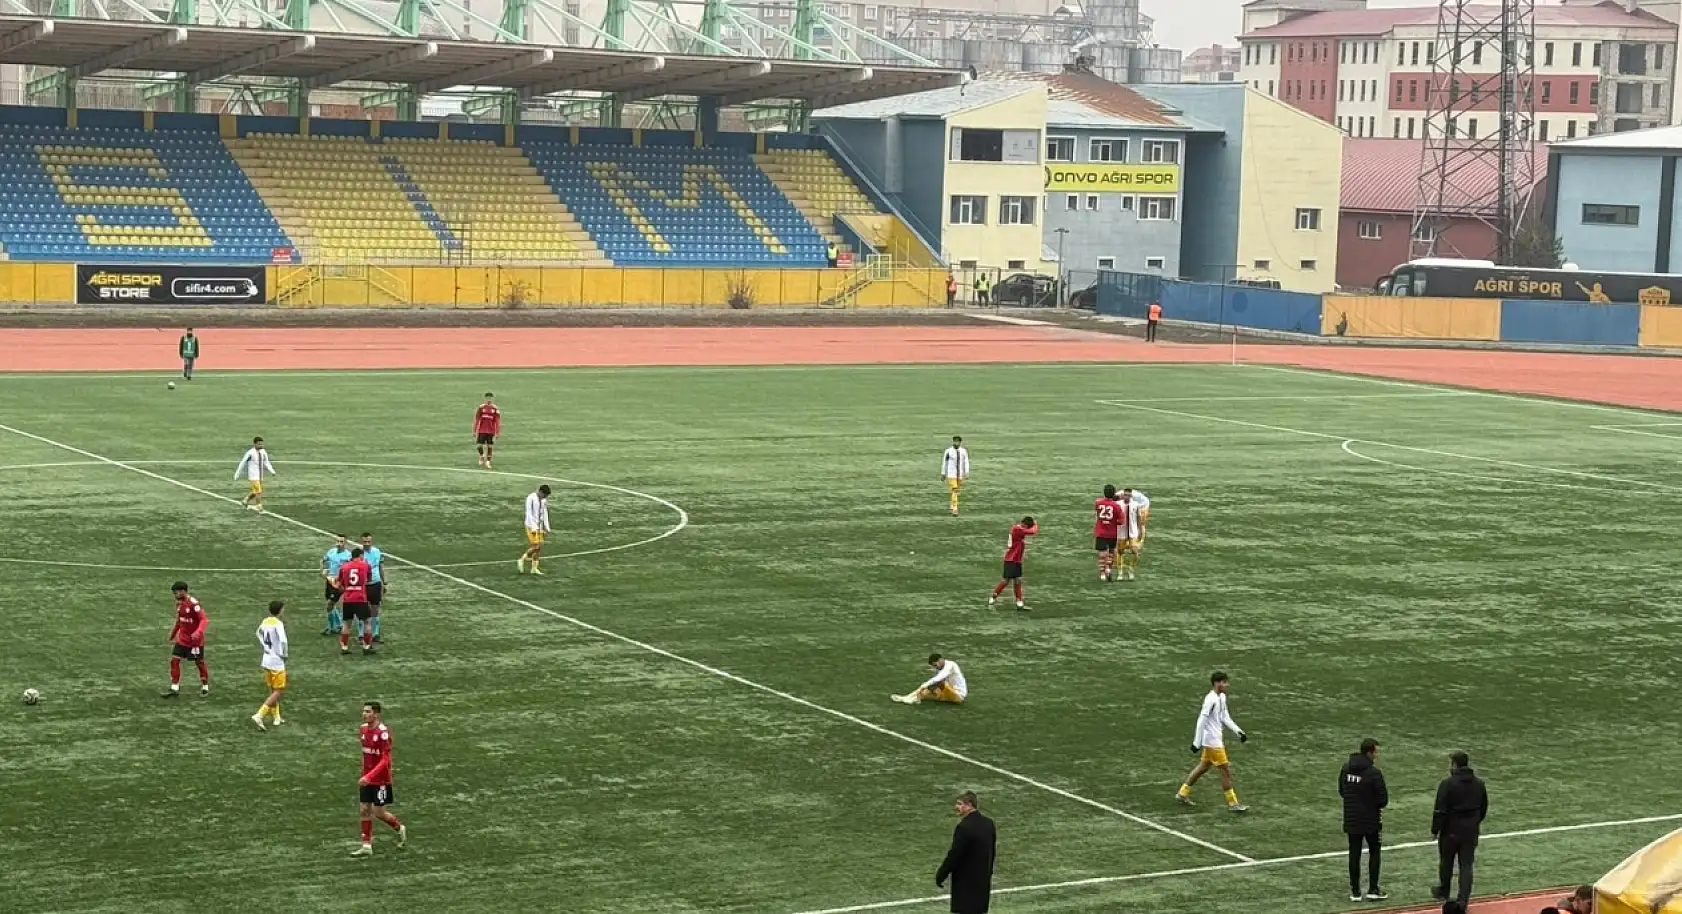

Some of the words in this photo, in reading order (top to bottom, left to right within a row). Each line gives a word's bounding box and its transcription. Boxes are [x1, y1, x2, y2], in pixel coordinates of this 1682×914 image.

[1100, 170, 1132, 184] AĞRI
[1135, 172, 1174, 185] SPOR
[121, 273, 163, 286] SPOR
[1474, 277, 1514, 293] AĞRI
[1518, 280, 1562, 294] SPOR
[100, 287, 150, 298] STORE
[184, 284, 236, 294] sifir4.com
[1099, 504, 1114, 519] 23
[349, 568, 360, 585] 5
